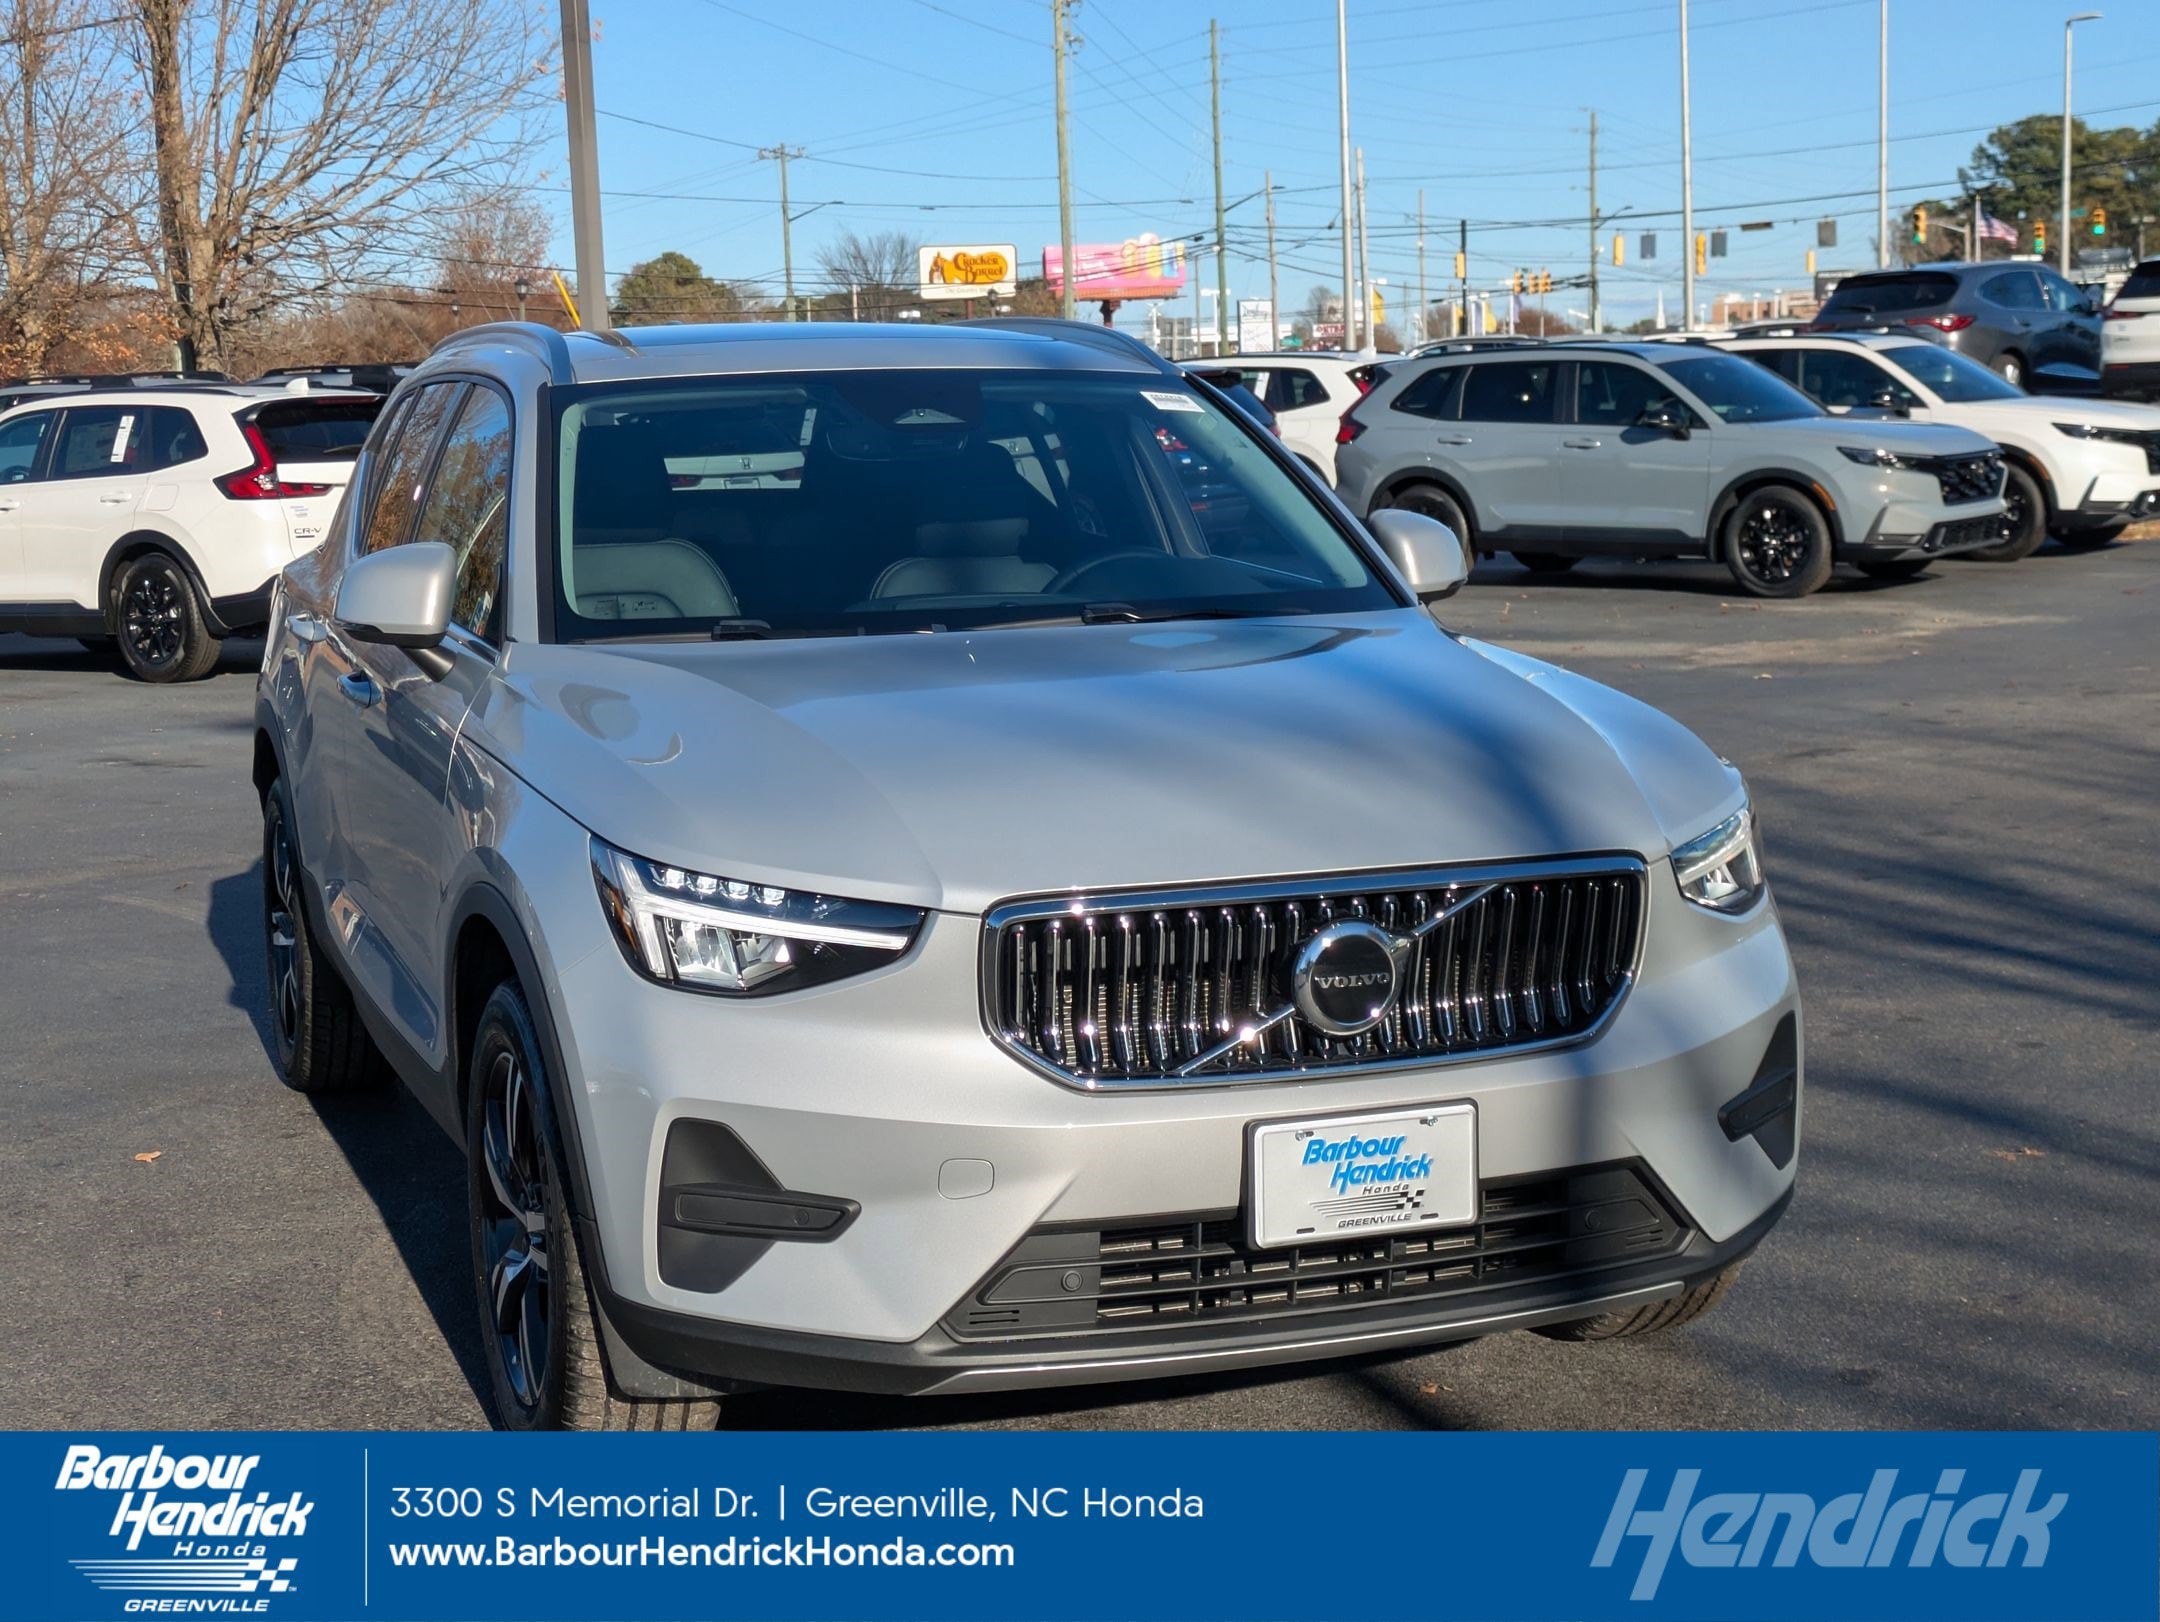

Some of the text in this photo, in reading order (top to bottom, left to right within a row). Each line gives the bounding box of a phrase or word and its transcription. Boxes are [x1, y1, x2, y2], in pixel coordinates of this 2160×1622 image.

[954, 252, 998, 271] Cracker
[294, 527, 322, 535] CR-V
[1315, 972, 1390, 989] VOLVO
[1302, 1135, 1406, 1165] Barbour
[1330, 1152, 1433, 1195] Hendrick
[1362, 1183, 1409, 1195] Honda
[1338, 1213, 1412, 1228] GREENVILLE
